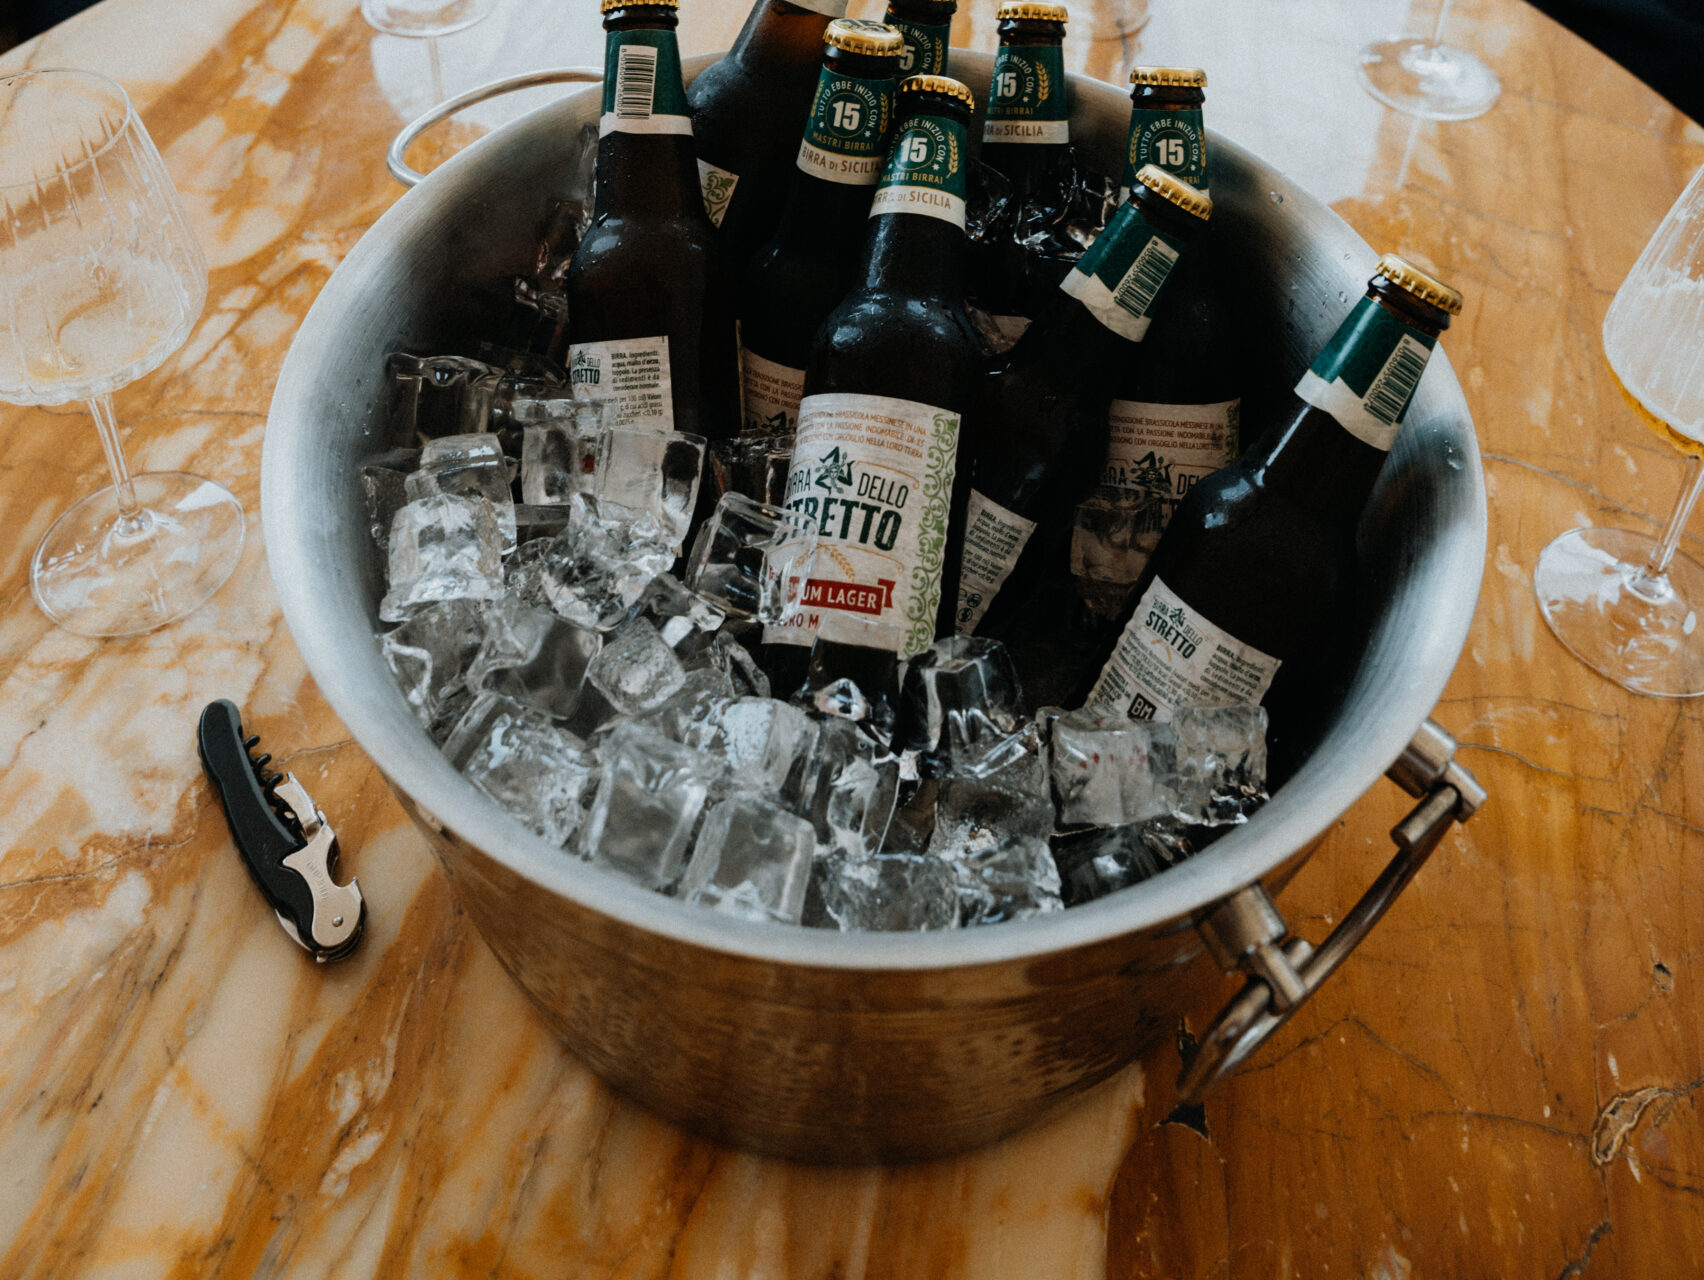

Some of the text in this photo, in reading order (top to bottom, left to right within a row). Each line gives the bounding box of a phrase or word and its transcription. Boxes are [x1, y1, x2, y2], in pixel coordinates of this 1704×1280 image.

[899, 44, 916, 71] 5
[911, 28, 932, 69] INIZIO CON
[996, 72, 1018, 97] 15
[1010, 55, 1034, 94] INIZIO CON
[818, 81, 878, 128] TUTTO EBBE INIZIO CON
[832, 101, 861, 131] 15
[812, 131, 874, 151] MASTRI BIRRAI
[899, 118, 920, 133] EBBE
[921, 119, 945, 142] INIZIO
[935, 144, 946, 163] CON
[1004, 124, 1044, 136] SICILIA
[1140, 118, 1199, 162] TUTTO EBBE INIZIO CON
[802, 146, 826, 169] BIRRA
[900, 137, 928, 163] 15
[1155, 138, 1185, 166] 15
[912, 172, 944, 184] BIRRAI
[909, 190, 952, 209] SICILIA
[1145, 418, 1180, 427] BRASSICOLA
[1181, 421, 1208, 430] MESSINESE
[1146, 429, 1175, 438] PASSIONE
[1135, 437, 1146, 446] CON
[1148, 439, 1178, 448] ORGOGLIO
[857, 472, 909, 509] DELLO
[827, 587, 877, 609] LAGER
[1146, 611, 1196, 659] STRETTO
[1182, 624, 1203, 646] DELLO
[1131, 698, 1154, 721] BM
